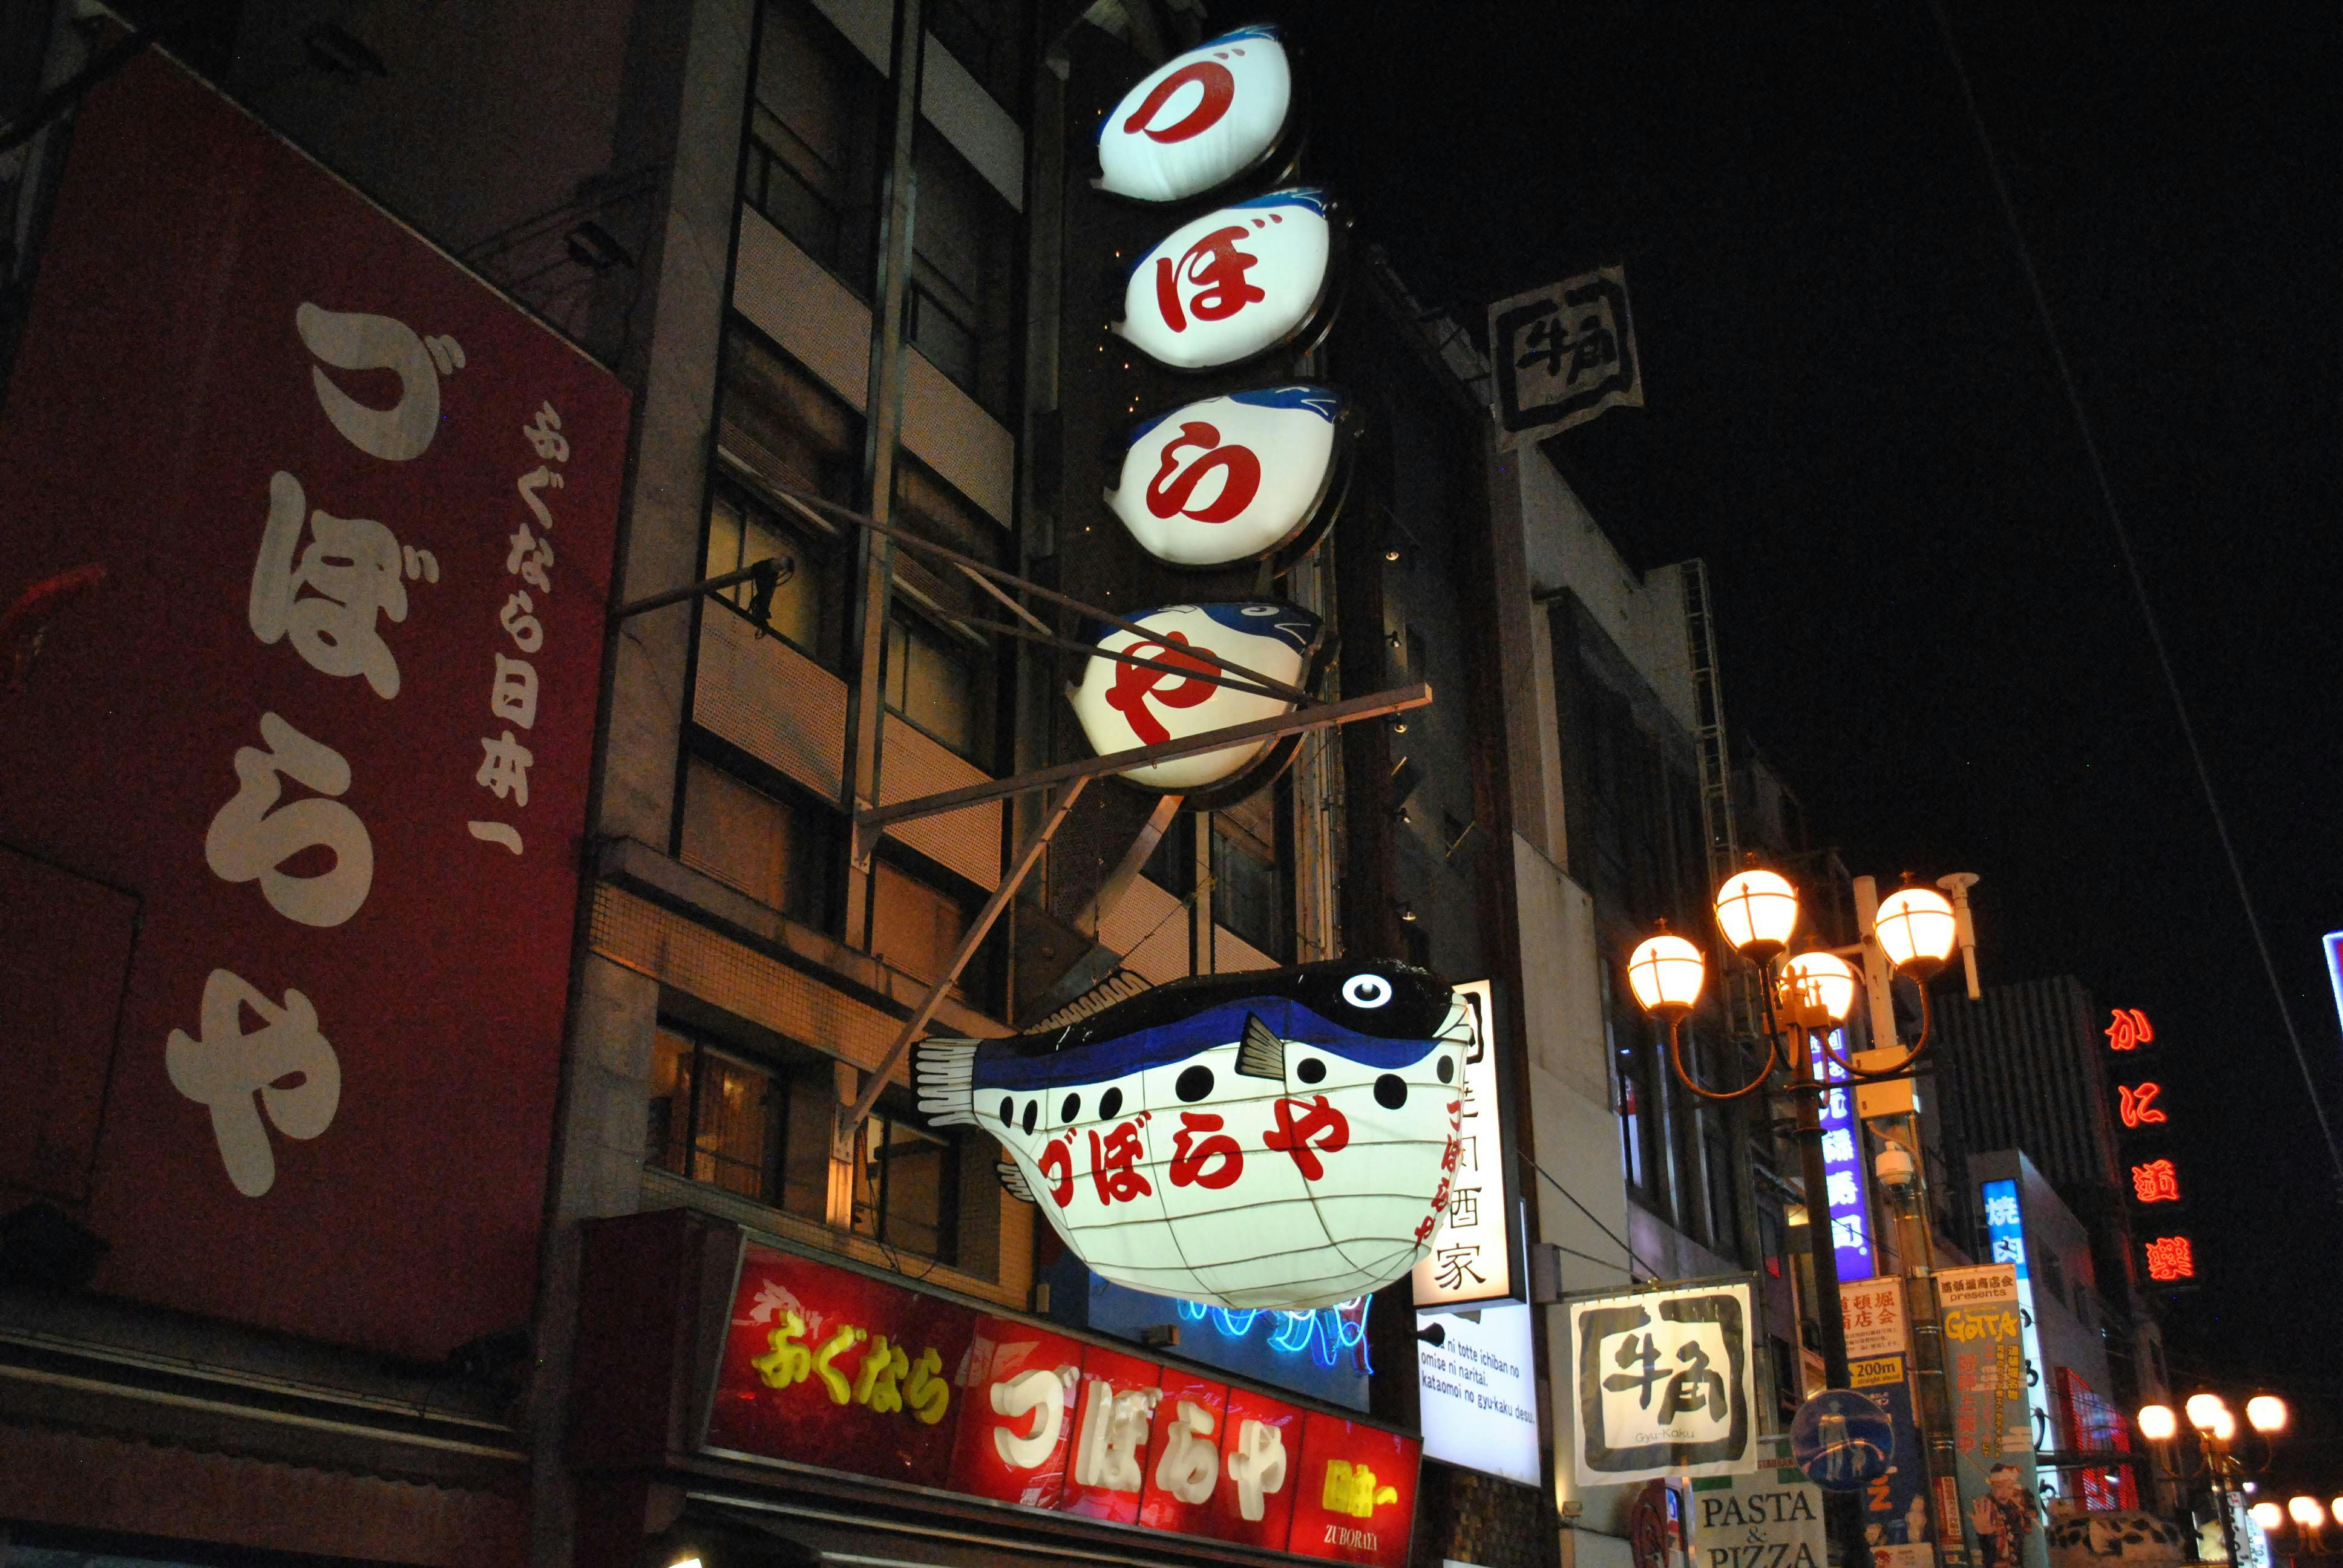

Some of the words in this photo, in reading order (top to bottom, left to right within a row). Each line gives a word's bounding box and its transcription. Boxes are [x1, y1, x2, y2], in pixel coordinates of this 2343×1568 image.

[1516, 315, 1617, 384] 牛角
[468, 400, 569, 855] ふぐなら日本一
[166, 301, 465, 1197] づぼらや
[1038, 1095, 1349, 1208] づぼらや
[1985, 1195, 2024, 1263] 焼肉
[1941, 1275, 2013, 1293] 道頓堀商店会
[1950, 1288, 2007, 1302] presents
[751, 1308, 949, 1425] ふぐなら
[1421, 1351, 1446, 1371] omise
[1449, 1362, 1456, 1375] ni
[1459, 1365, 1488, 1387] naritai.
[1447, 1339, 1455, 1354] ni
[1458, 1343, 1478, 1362] totte
[1480, 1350, 1508, 1373] ichiban
[1510, 1365, 1519, 1379] no
[1856, 1362, 1895, 1377] 200m
[1422, 1370, 1461, 1399] kataomoi
[1464, 1388, 1474, 1403] no
[1478, 1394, 1513, 1416] gyu-kaku
[1602, 1333, 1728, 1425] 牛角
[1857, 1376, 1881, 1385] straight
[1883, 1374, 1900, 1382] ahead
[990, 1365, 1286, 1521] づぼらや
[1636, 1428, 1695, 1443] Gyu-Kaku
[1702, 1491, 1816, 1527] PASTA
[1324, 1524, 1377, 1551] ZUBORAYA
[1746, 1526, 1768, 1543] &
[1708, 1541, 1820, 1568] PIZZA
